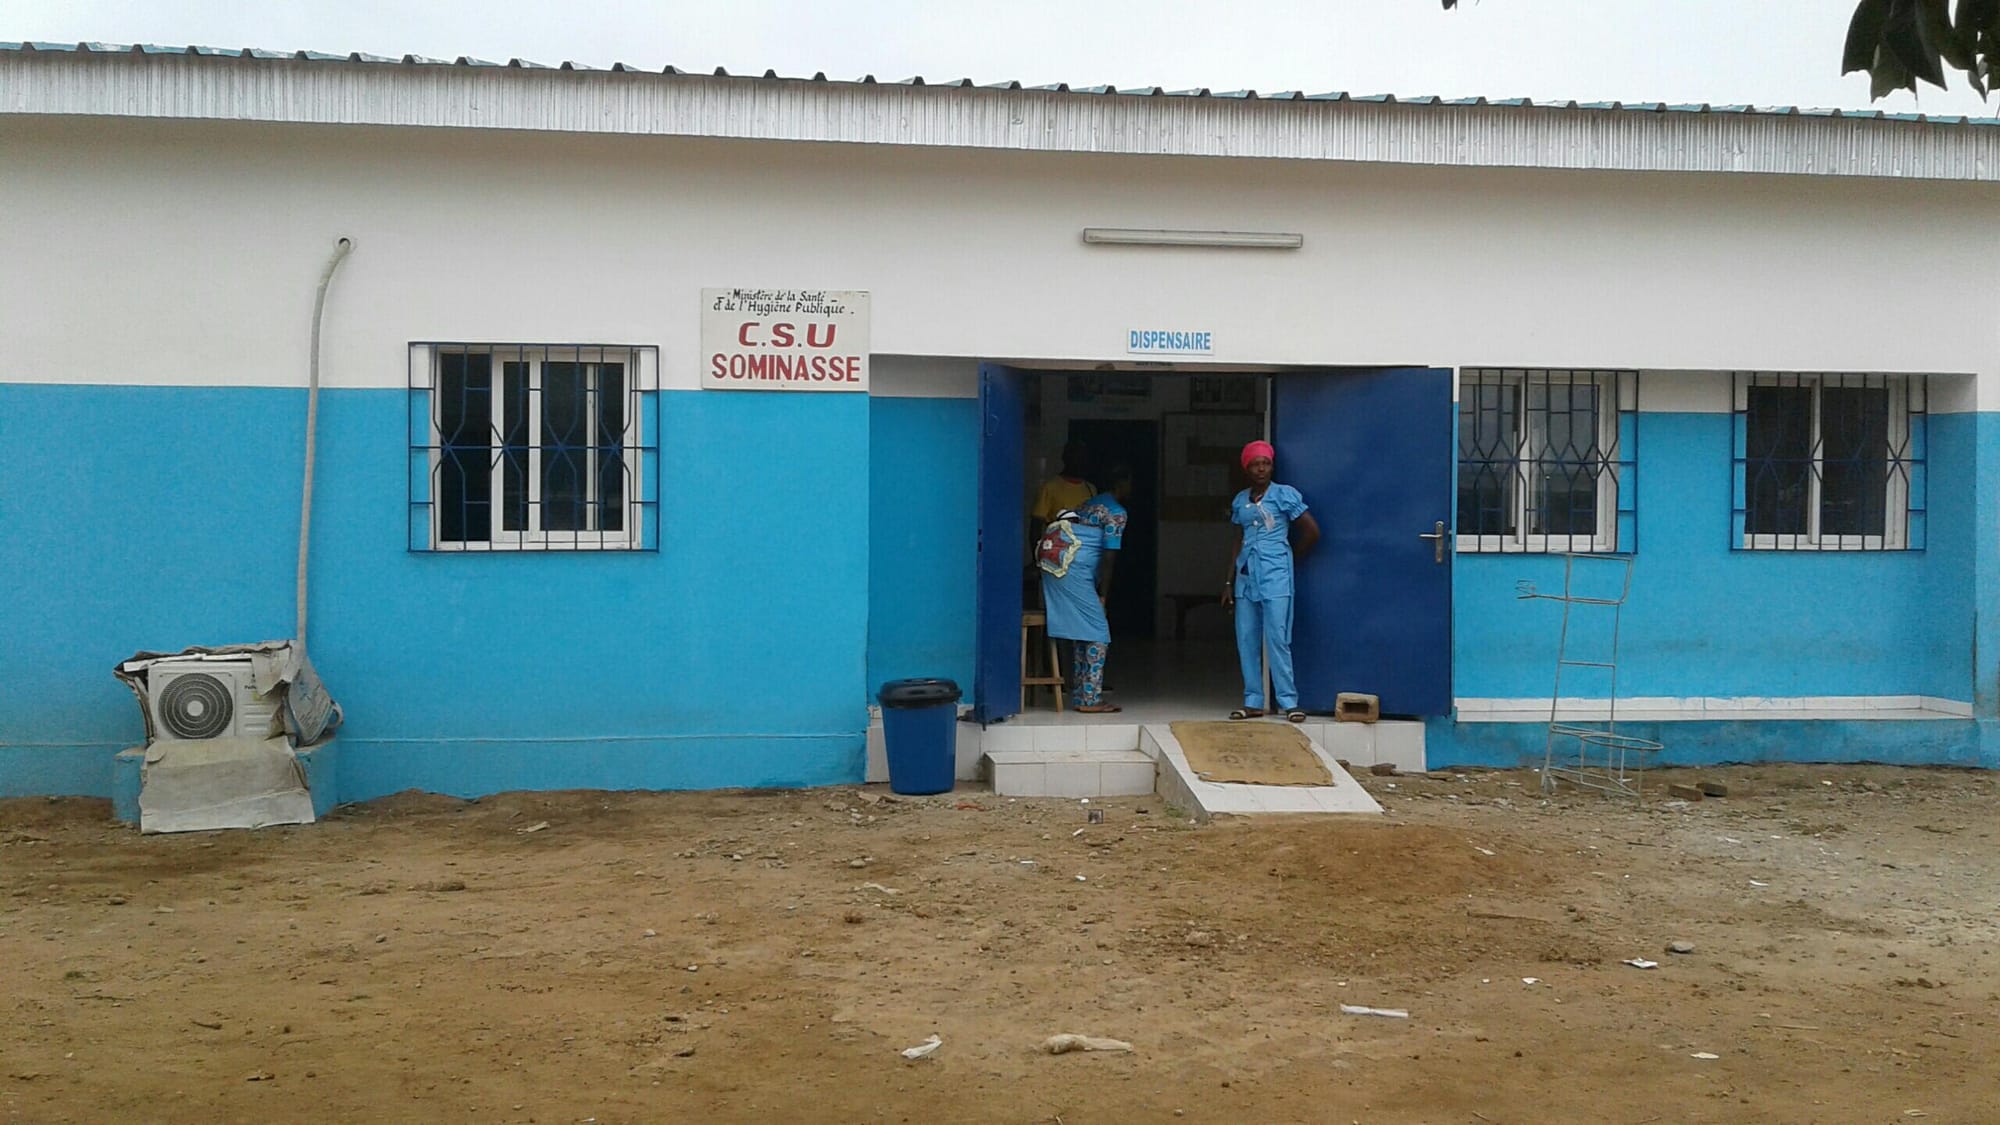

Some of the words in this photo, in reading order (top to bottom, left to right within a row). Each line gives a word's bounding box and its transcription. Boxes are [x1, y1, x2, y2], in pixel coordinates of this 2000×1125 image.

[724, 299, 735, 311] de
[733, 288, 774, 301] Ministère
[774, 290, 786, 301] de
[787, 290, 796, 301] la
[800, 290, 826, 302] Santé
[738, 322, 836, 348] C.S.U
[1130, 330, 1211, 350] DISPENSAIRE
[712, 353, 860, 382] SOMINASSE
